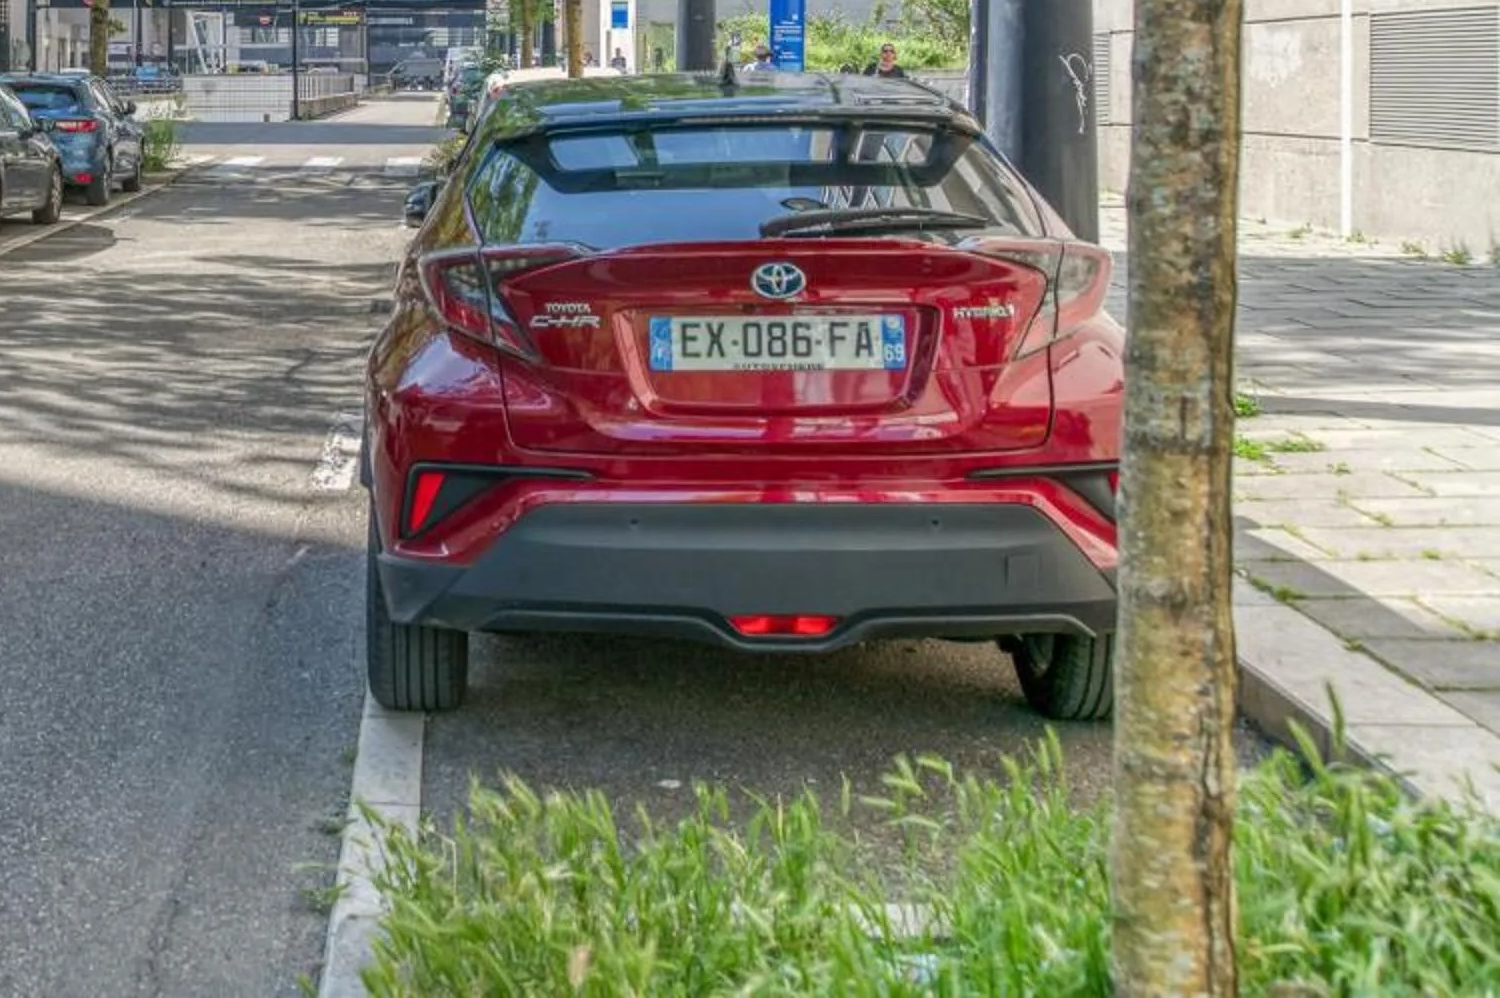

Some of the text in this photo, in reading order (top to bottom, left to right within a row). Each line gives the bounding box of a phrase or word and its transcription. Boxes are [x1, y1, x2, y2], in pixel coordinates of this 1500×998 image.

[544, 302, 592, 313] TOYOTA
[530, 315, 601, 328] C-HR
[680, 321, 874, 359] EX-086-FA
[884, 343, 904, 362] 69
